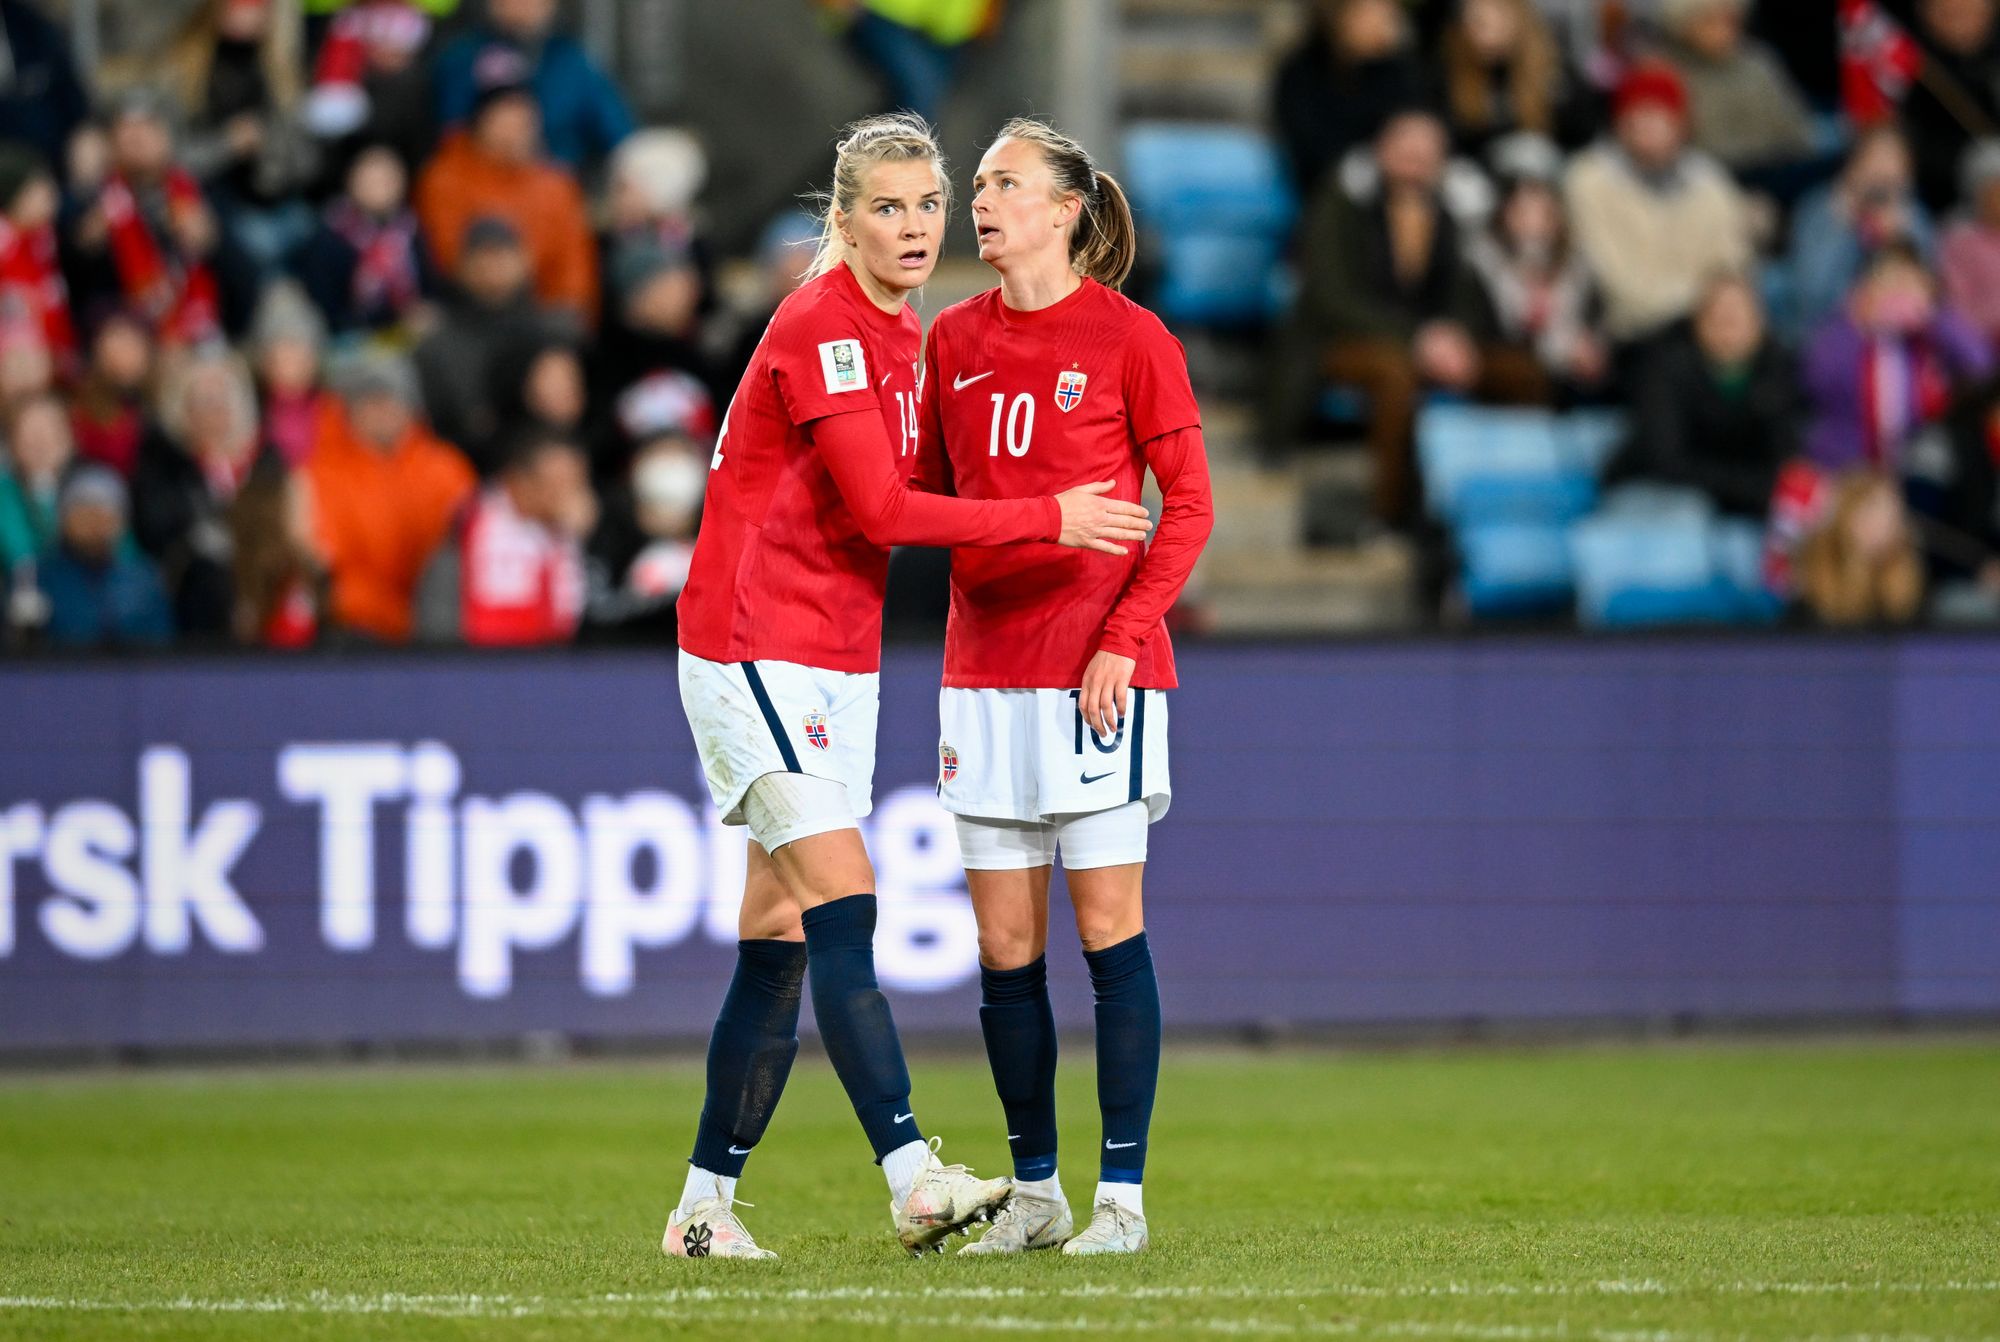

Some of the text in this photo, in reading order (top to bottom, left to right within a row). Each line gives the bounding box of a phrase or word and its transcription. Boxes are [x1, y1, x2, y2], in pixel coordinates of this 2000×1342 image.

[895, 390, 919, 457] 14
[989, 392, 1035, 458] 10
[278, 740, 982, 998] Tippg
